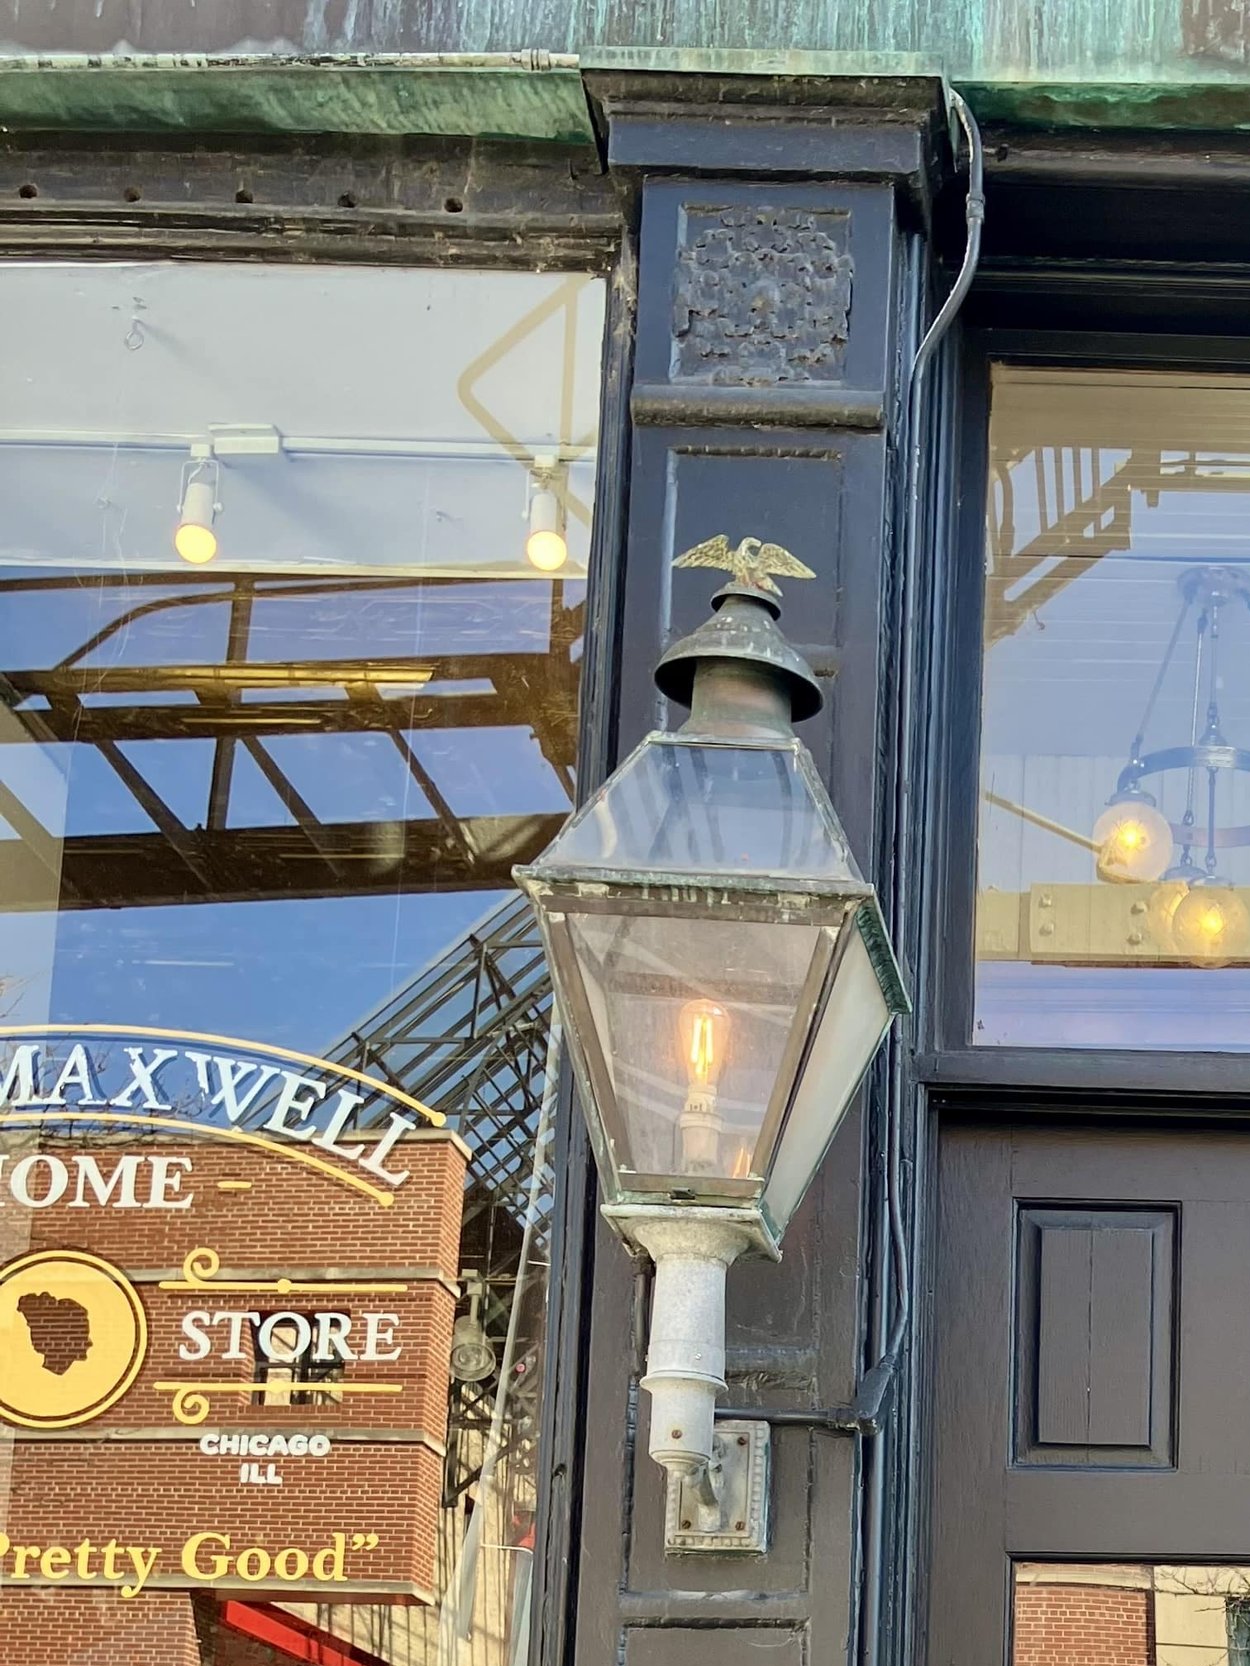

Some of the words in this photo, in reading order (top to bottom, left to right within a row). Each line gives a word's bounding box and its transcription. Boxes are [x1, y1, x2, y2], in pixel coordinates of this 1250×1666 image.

[0, 1043, 417, 1187] MAXWELL
[0, 1153, 194, 1209] OME
[178, 1310, 402, 1363] STORE
[200, 1433, 331, 1457] CHICAGO
[240, 1464, 283, 1486] ILL
